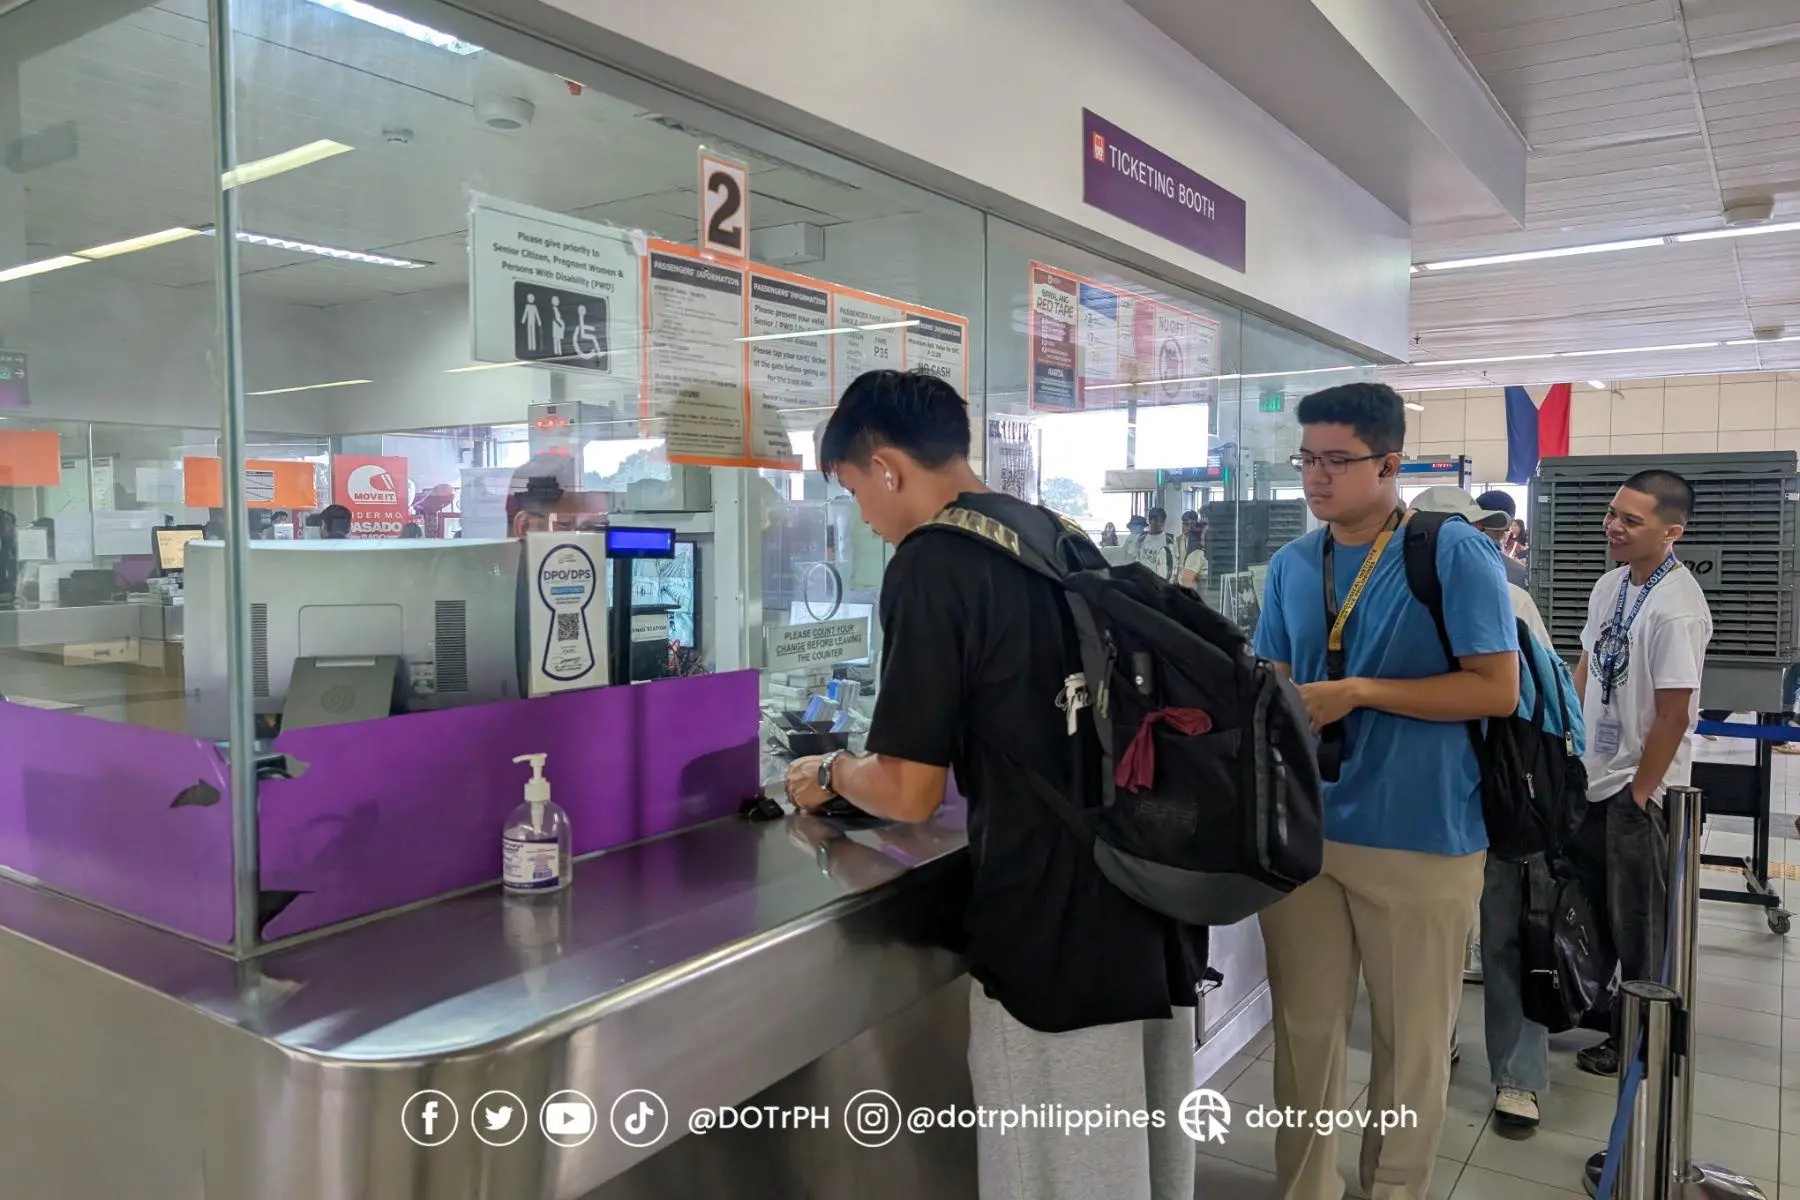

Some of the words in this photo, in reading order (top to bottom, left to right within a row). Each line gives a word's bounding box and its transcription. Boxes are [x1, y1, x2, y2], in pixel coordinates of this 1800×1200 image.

[1109, 144, 1174, 199] TICKETING
[1179, 183, 1215, 220] BOOTH
[708, 171, 742, 251] 2
[518, 232, 542, 244] Please
[544, 238, 561, 248] give
[563, 243, 590, 256] priority
[592, 249, 600, 258] to
[493, 242, 519, 255] Senior
[521, 249, 551, 263] Citizen,
[553, 256, 587, 270] Pregnant
[589, 264, 616, 277] Women
[618, 269, 624, 278] &
[502, 261, 533, 274] Persons
[535, 268, 554, 278] With
[556, 272, 589, 287] Disability
[591, 279, 615, 292] (PWD)
[696, 270, 739, 286] INFORMATION
[790, 291, 826, 305] INFORMATION
[1037, 297, 1053, 312] RED
[1055, 302, 1074, 318] TAPE
[874, 346, 889, 359] P35
[931, 364, 951, 377] CASH
[351, 521, 402, 533] ASADO
[543, 568, 592, 581] DPO/DPS
[1646, 557, 1676, 588] COLLEGE
[784, 628, 811, 640] PLEASE
[813, 626, 835, 637] COUNT
[837, 624, 855, 634] YOUR
[776, 642, 806, 655] CHANGE
[807, 638, 833, 650] BEFORE
[834, 635, 862, 646] LEAVING
[798, 653, 810, 663] THE
[812, 648, 844, 661] COUNTER
